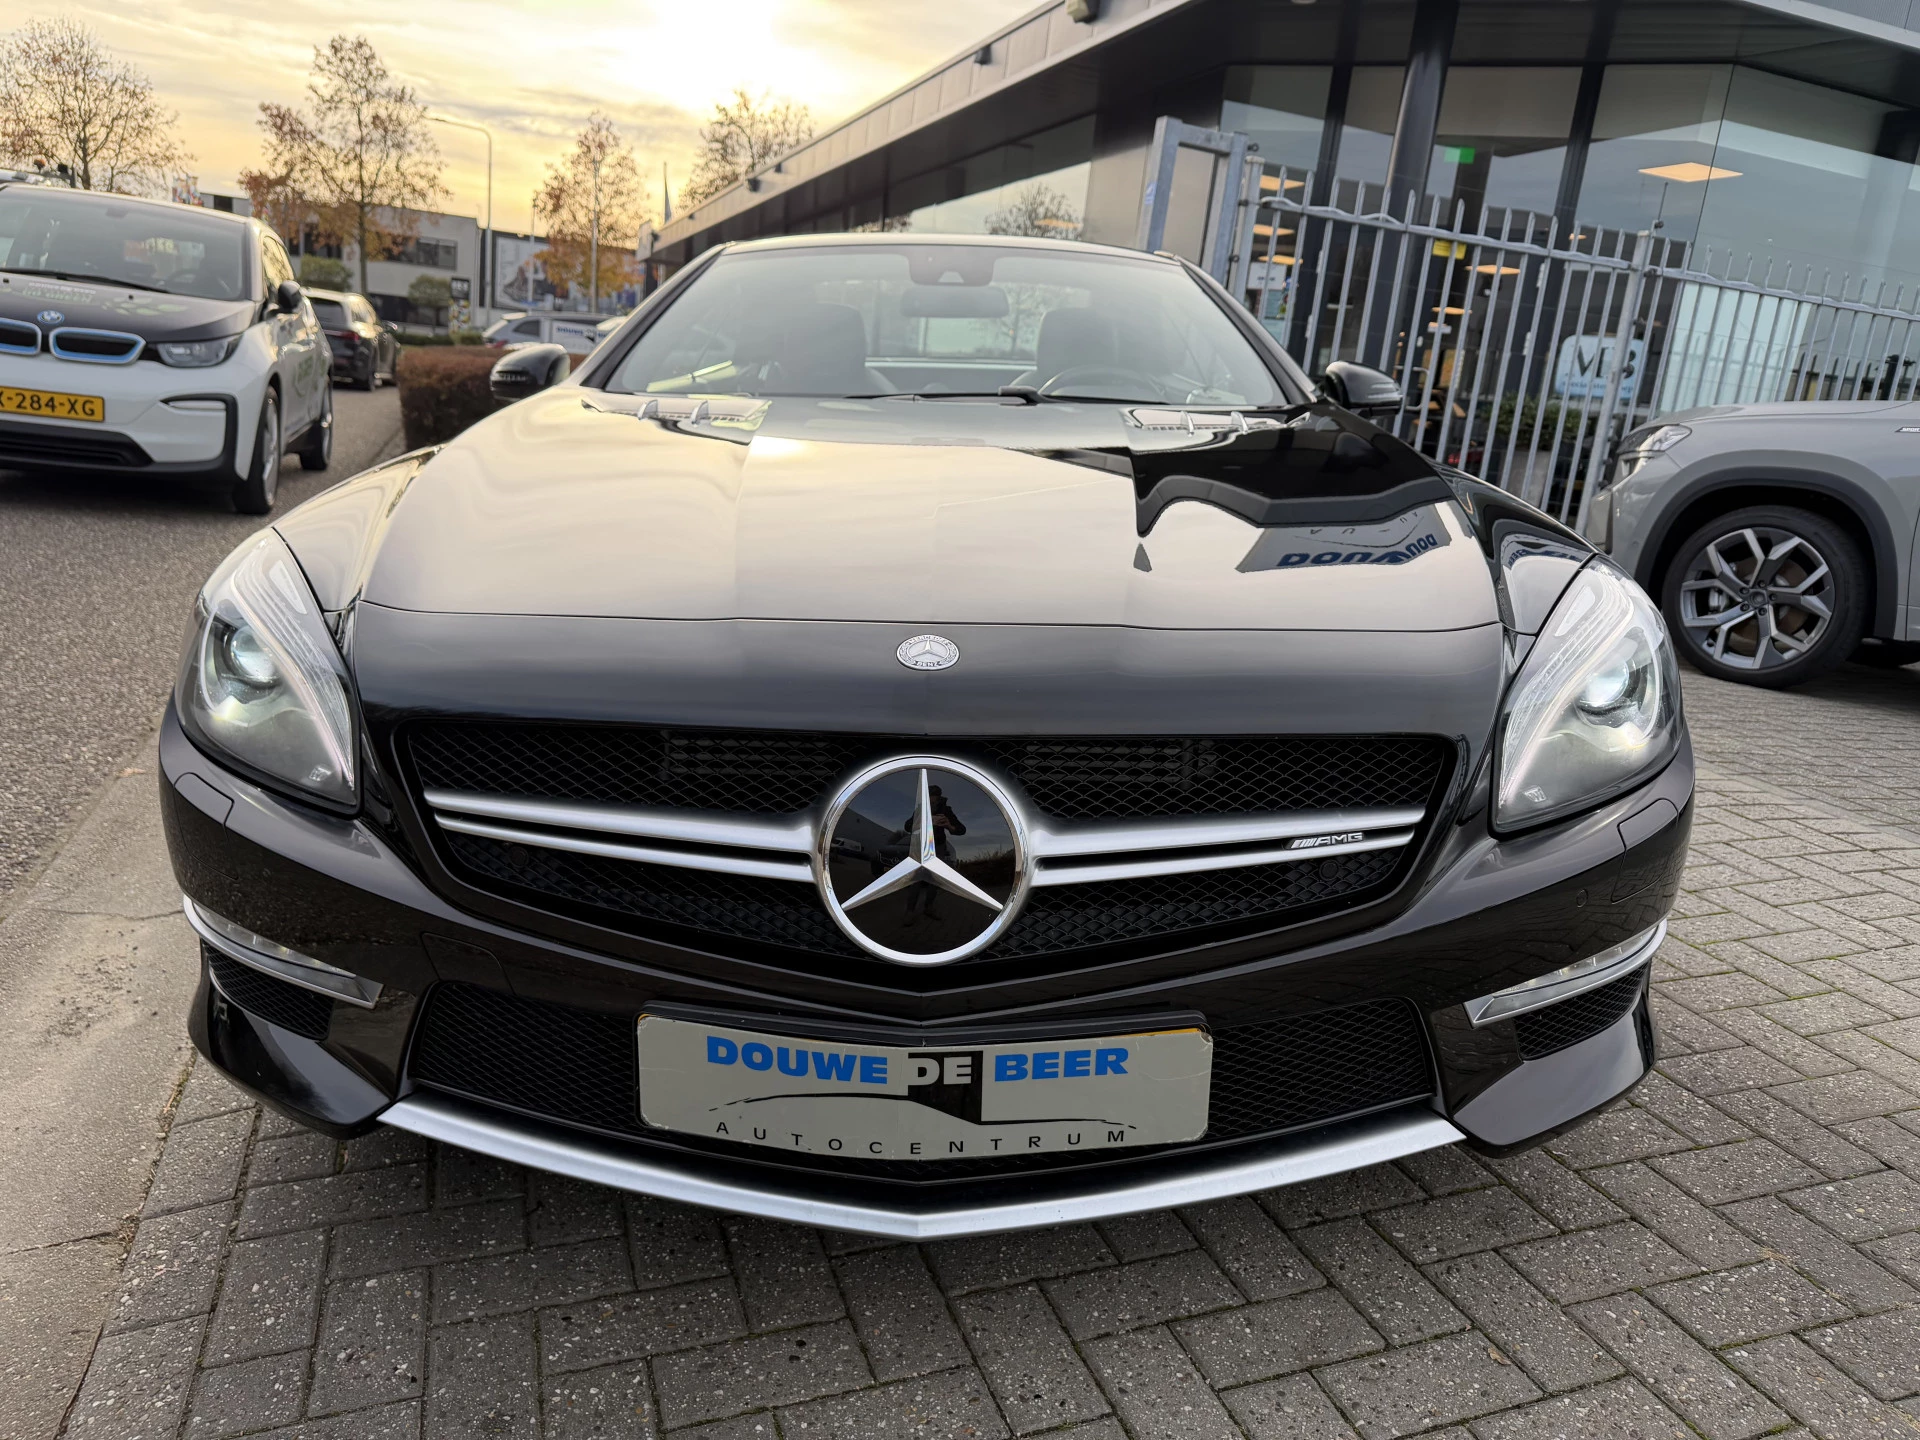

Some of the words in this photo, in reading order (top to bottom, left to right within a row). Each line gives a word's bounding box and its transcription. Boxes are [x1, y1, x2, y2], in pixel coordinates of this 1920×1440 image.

[706, 1035, 888, 1085] DOUWE
[910, 1056, 972, 1086] DE
[994, 1047, 1129, 1084] BEER
[716, 1120, 1125, 1154] AUTOCENTRUM
